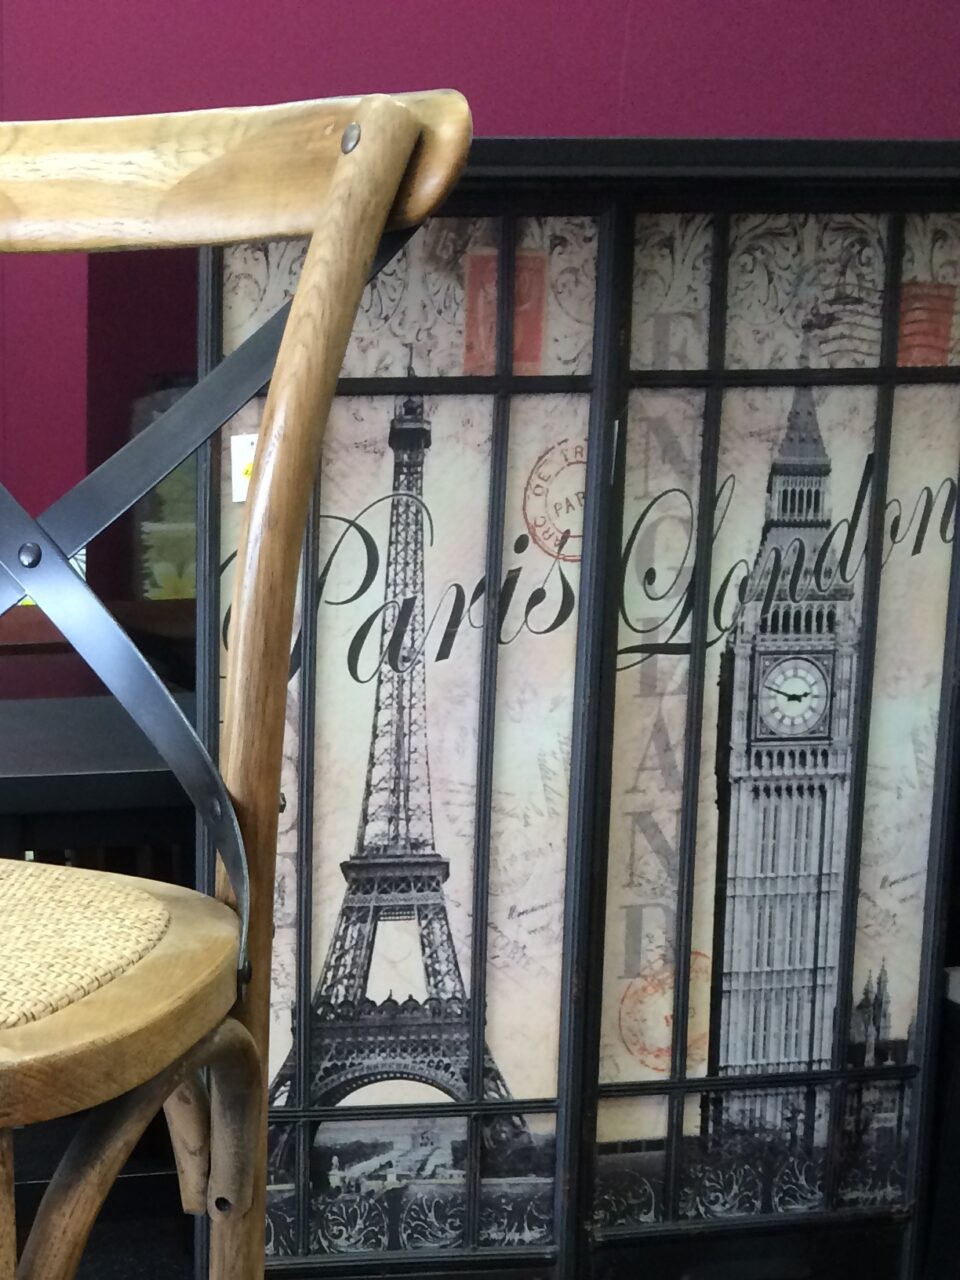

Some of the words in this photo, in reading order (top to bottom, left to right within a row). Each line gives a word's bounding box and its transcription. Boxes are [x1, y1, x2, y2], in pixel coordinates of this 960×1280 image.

[222, 493, 575, 684] Paris
[553, 491, 585, 517] PAR
[617, 454, 957, 671] London
